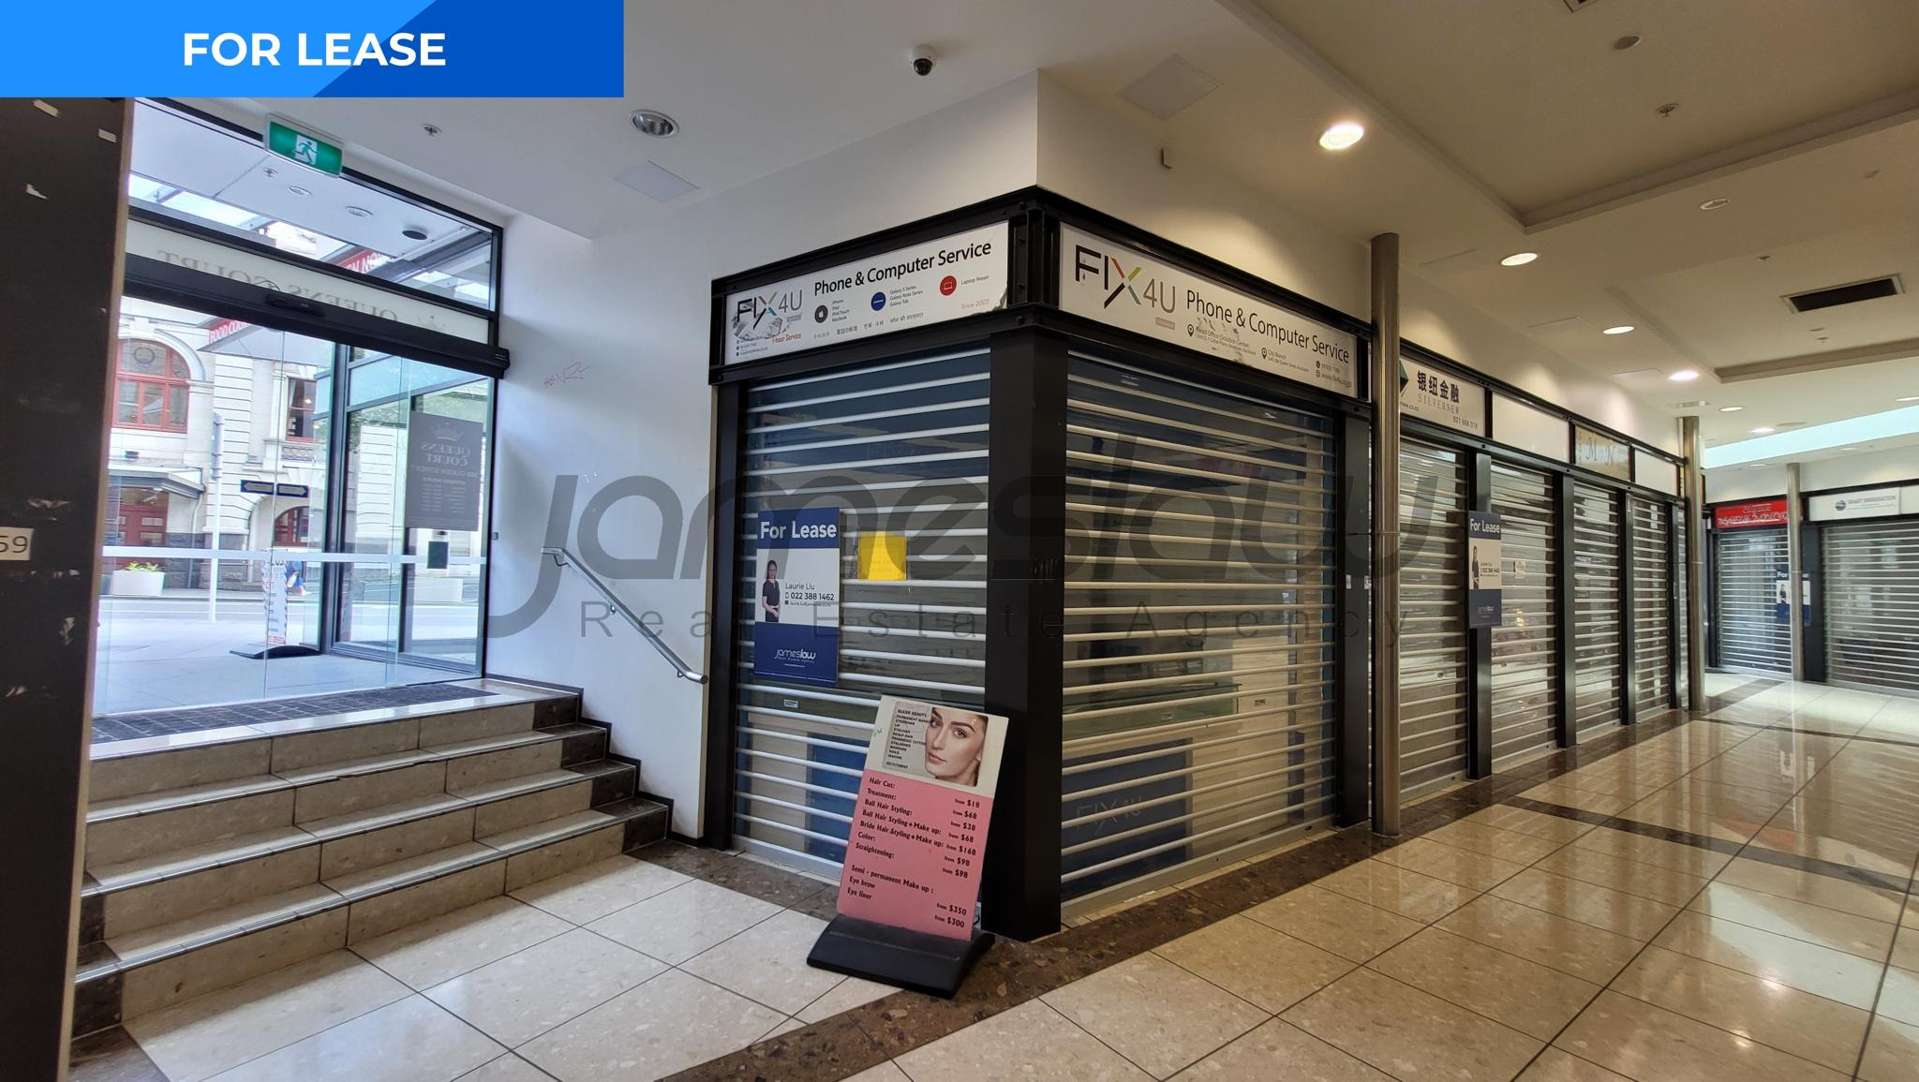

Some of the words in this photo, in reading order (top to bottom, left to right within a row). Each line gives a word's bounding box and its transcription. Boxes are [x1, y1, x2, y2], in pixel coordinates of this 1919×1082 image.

[814, 277, 852, 296] Phone
[855, 270, 865, 287] &
[867, 255, 935, 283] Computer
[938, 242, 992, 266] Service
[1075, 244, 1176, 314] FIX4U
[1186, 289, 1233, 324] Phone
[1235, 307, 1246, 329] &
[1249, 312, 1310, 350] Computer
[1311, 334, 1350, 364] Service
[760, 521, 787, 539] For
[791, 521, 837, 539] Lease
[1470, 519, 1481, 533] For
[1482, 520, 1500, 534] Lease
[790, 592, 803, 600] 022
[804, 592, 818, 600] 388
[819, 592, 835, 601] 1462
[869, 777, 881, 785] Hair
[882, 780, 896, 789] Cut:
[867, 788, 897, 800] Treatment:
[864, 798, 876, 806] Ball
[877, 801, 889, 810] Hair
[891, 804, 913, 816] Styling:
[862, 809, 874, 817] Ball
[874, 812, 887, 821] Hair
[860, 820, 875, 830] Bride
[876, 823, 889, 833] Hair
[857, 831, 876, 841] Color:
[855, 842, 895, 860] Straightening:
[849, 875, 860, 885] Eye
[861, 877, 876, 889] brow
[851, 864, 865, 874] Semi
[870, 871, 902, 884] permanent
[903, 879, 920, 890] Make
[921, 885, 930, 894] up
[847, 887, 858, 896] Eye
[859, 890, 873, 901] liner
